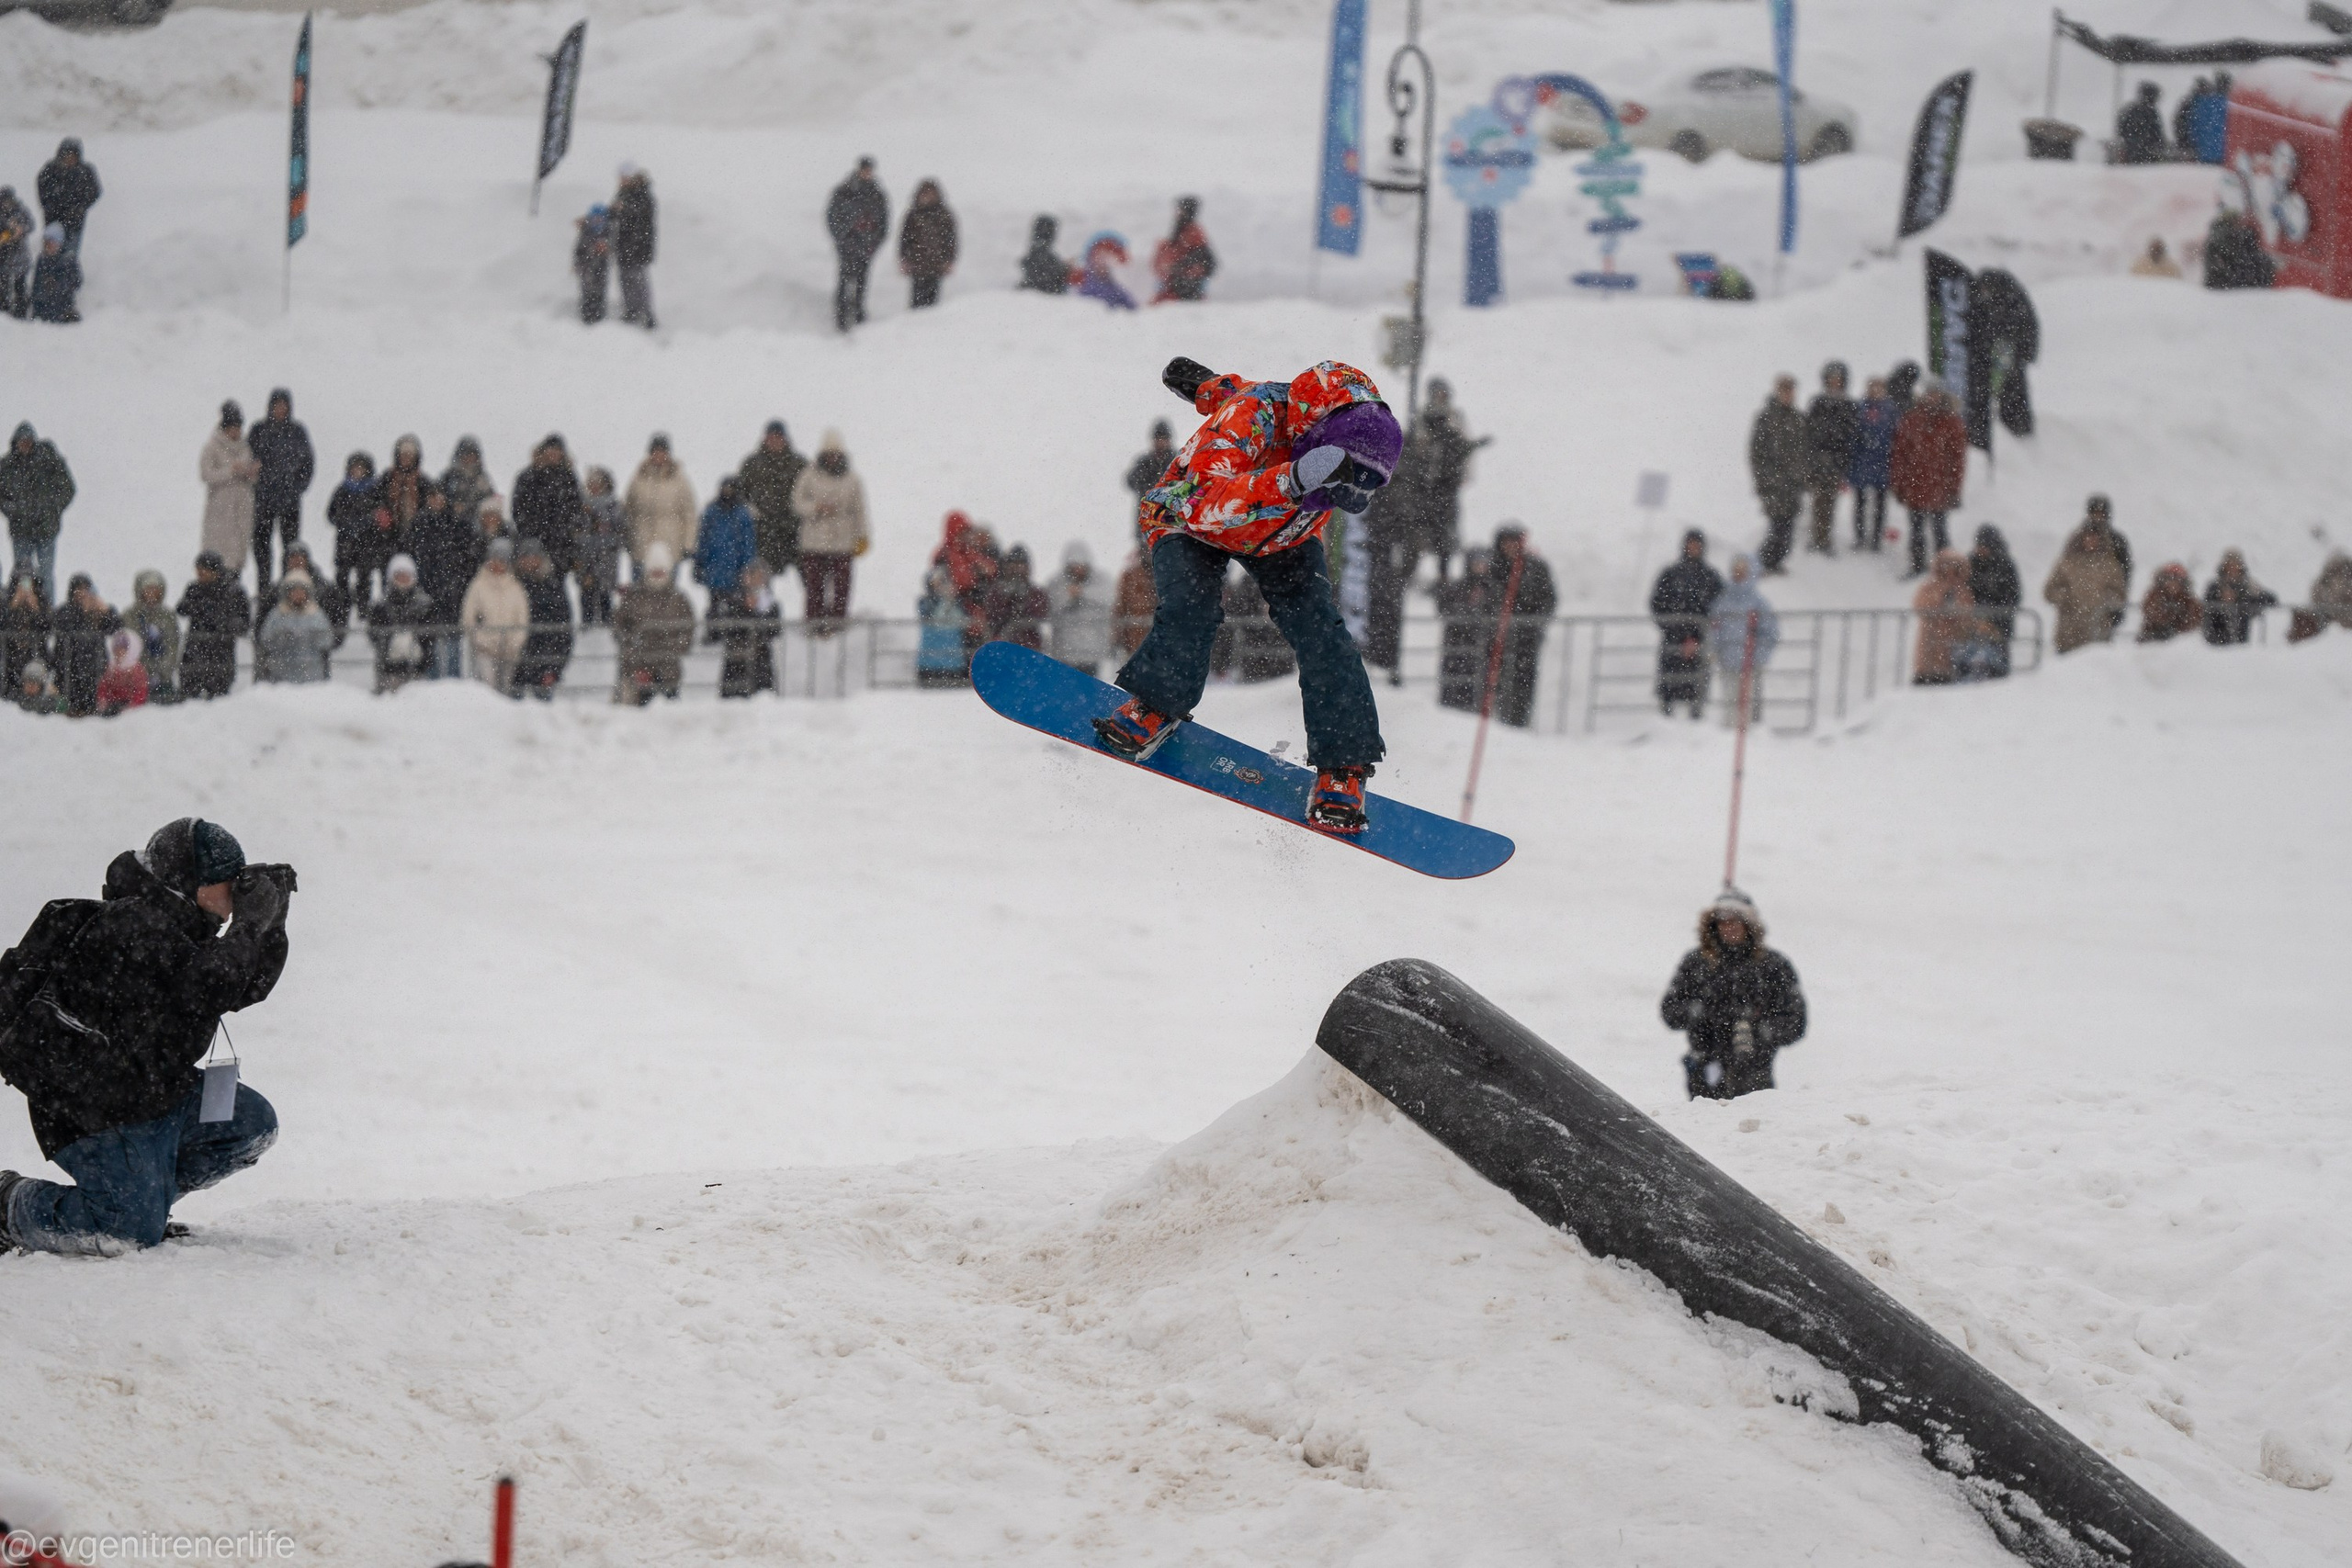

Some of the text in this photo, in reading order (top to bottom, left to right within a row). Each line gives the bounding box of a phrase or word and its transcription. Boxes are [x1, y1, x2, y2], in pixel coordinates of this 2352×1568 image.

[1216, 756, 1228, 767] OR
[1222, 759, 1237, 773] ARB
[1333, 783, 1343, 792] 32
